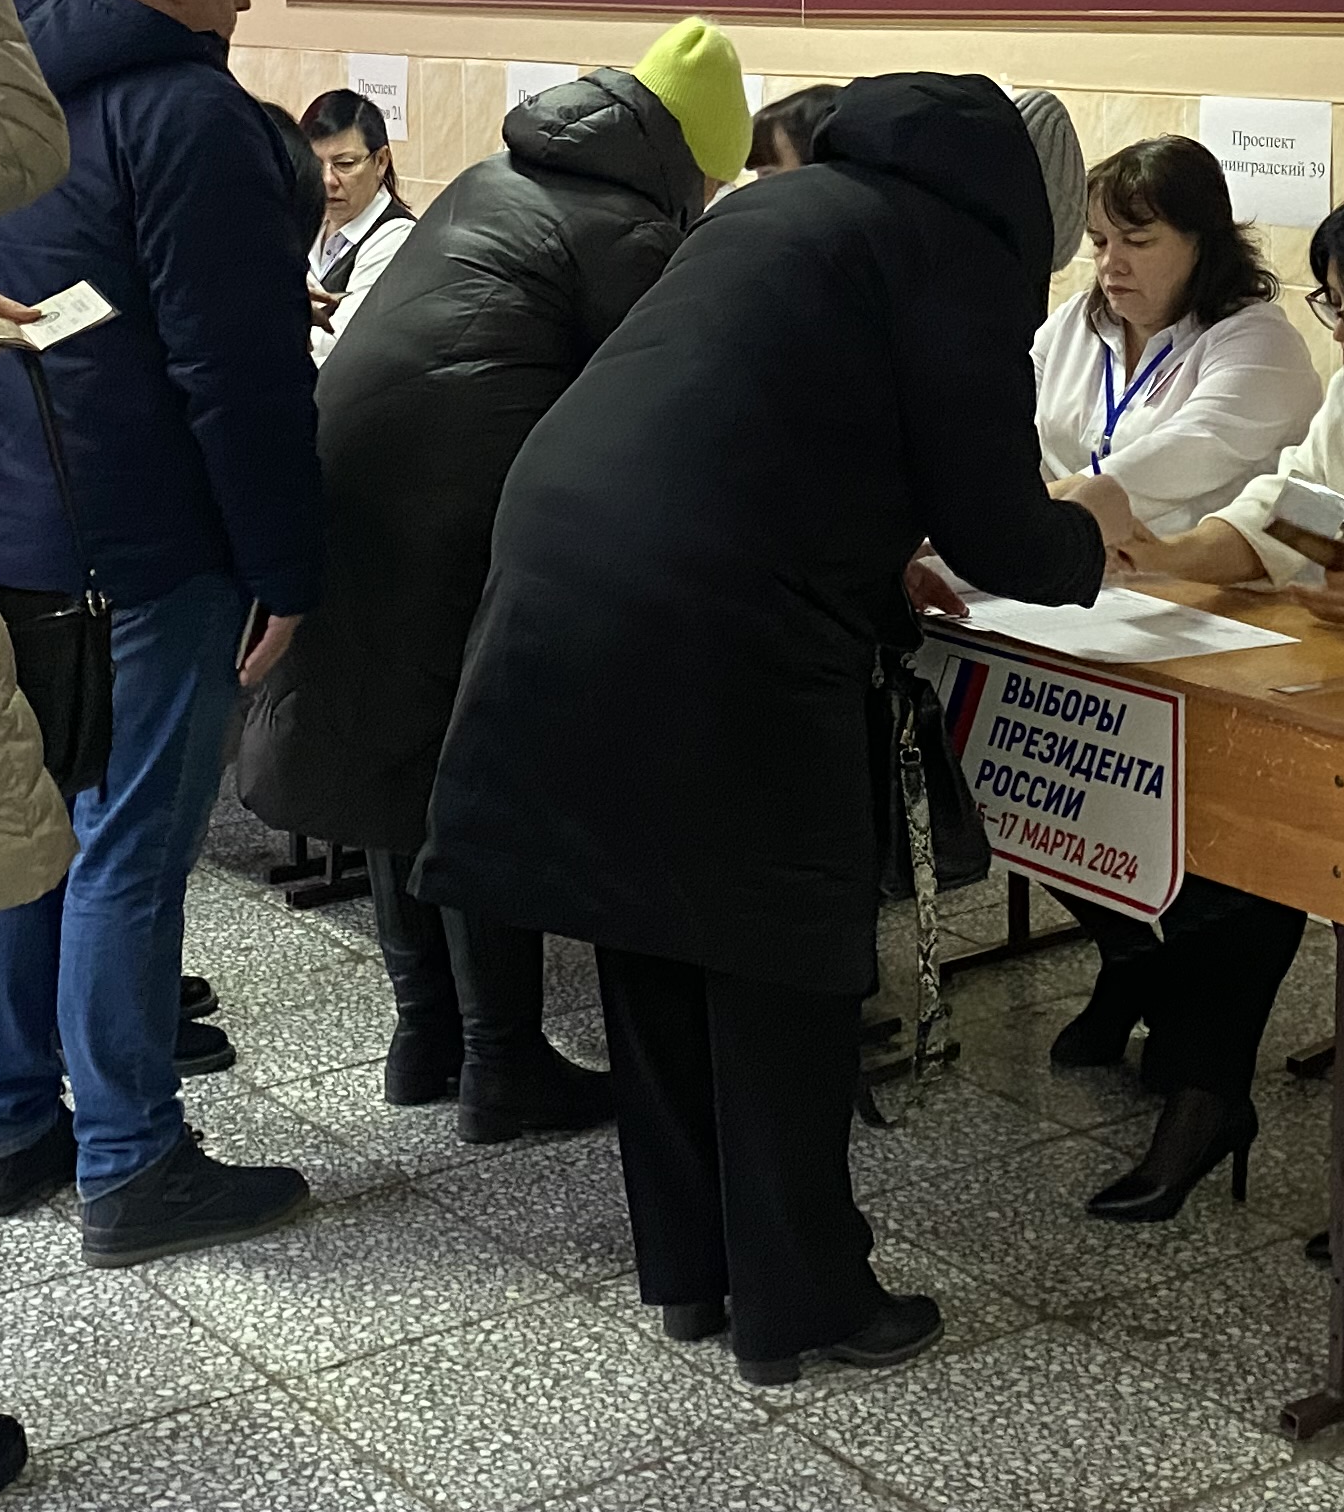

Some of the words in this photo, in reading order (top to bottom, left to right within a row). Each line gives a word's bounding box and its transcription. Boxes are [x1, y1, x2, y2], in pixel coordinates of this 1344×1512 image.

[358, 78, 397, 95] Проспект
[392, 105, 402, 120] 21
[1232, 130, 1296, 151] Проспект
[1221, 160, 1305, 177] нинградский
[1308, 161, 1326, 178] 39
[1001, 672, 1128, 736] ВЫБОРЫ
[988, 716, 1165, 799] ПРЕЗИДЕНТА
[975, 759, 1086, 821] РОССИИ
[1018, 818, 1086, 866] МАРТА
[1088, 842, 1139, 884] 2024
